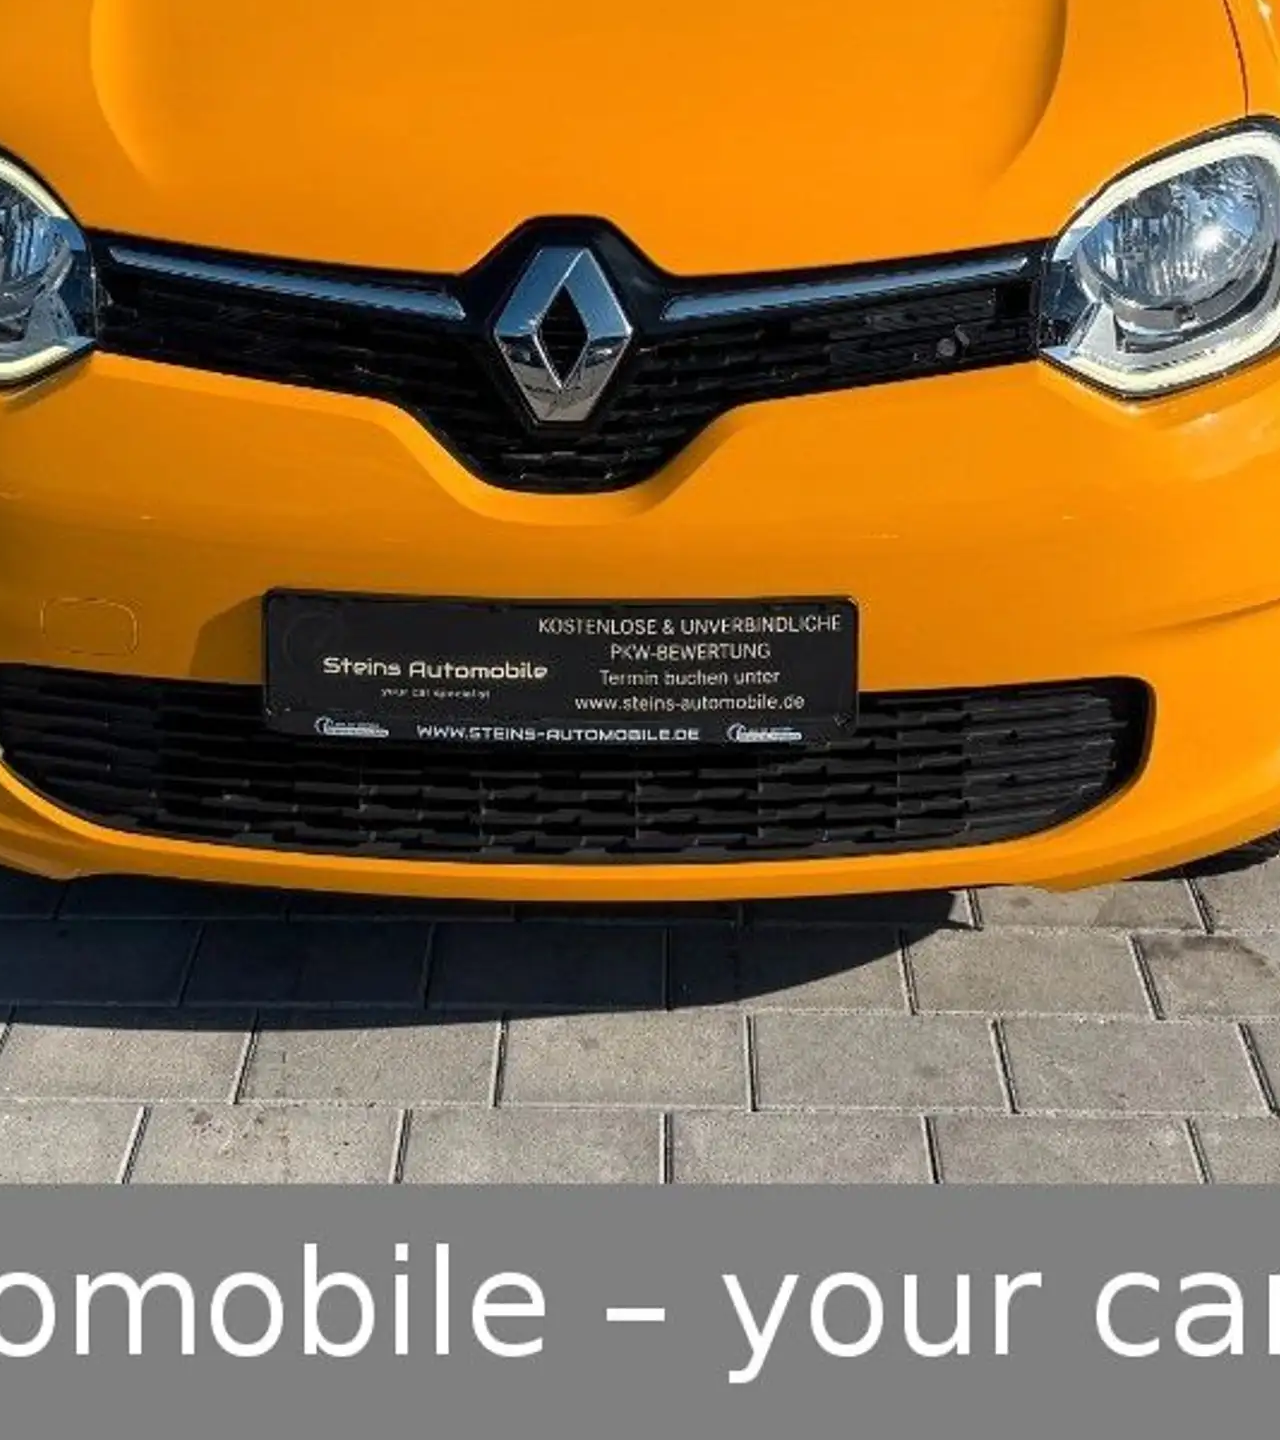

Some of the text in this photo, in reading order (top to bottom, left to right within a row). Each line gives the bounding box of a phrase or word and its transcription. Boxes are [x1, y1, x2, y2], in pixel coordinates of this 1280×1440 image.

[538, 613, 842, 636] KOSTENLOSE & UNVERBINDLICHE
[610, 642, 771, 661] PKW-BEWERTUNG
[323, 656, 549, 680] Steins Automobile
[600, 668, 781, 687] Termin buchen unter
[574, 692, 806, 711] www.steins-automobile.de
[417, 723, 700, 742] WWW.STEINS-AUTOMOBILE.DE
